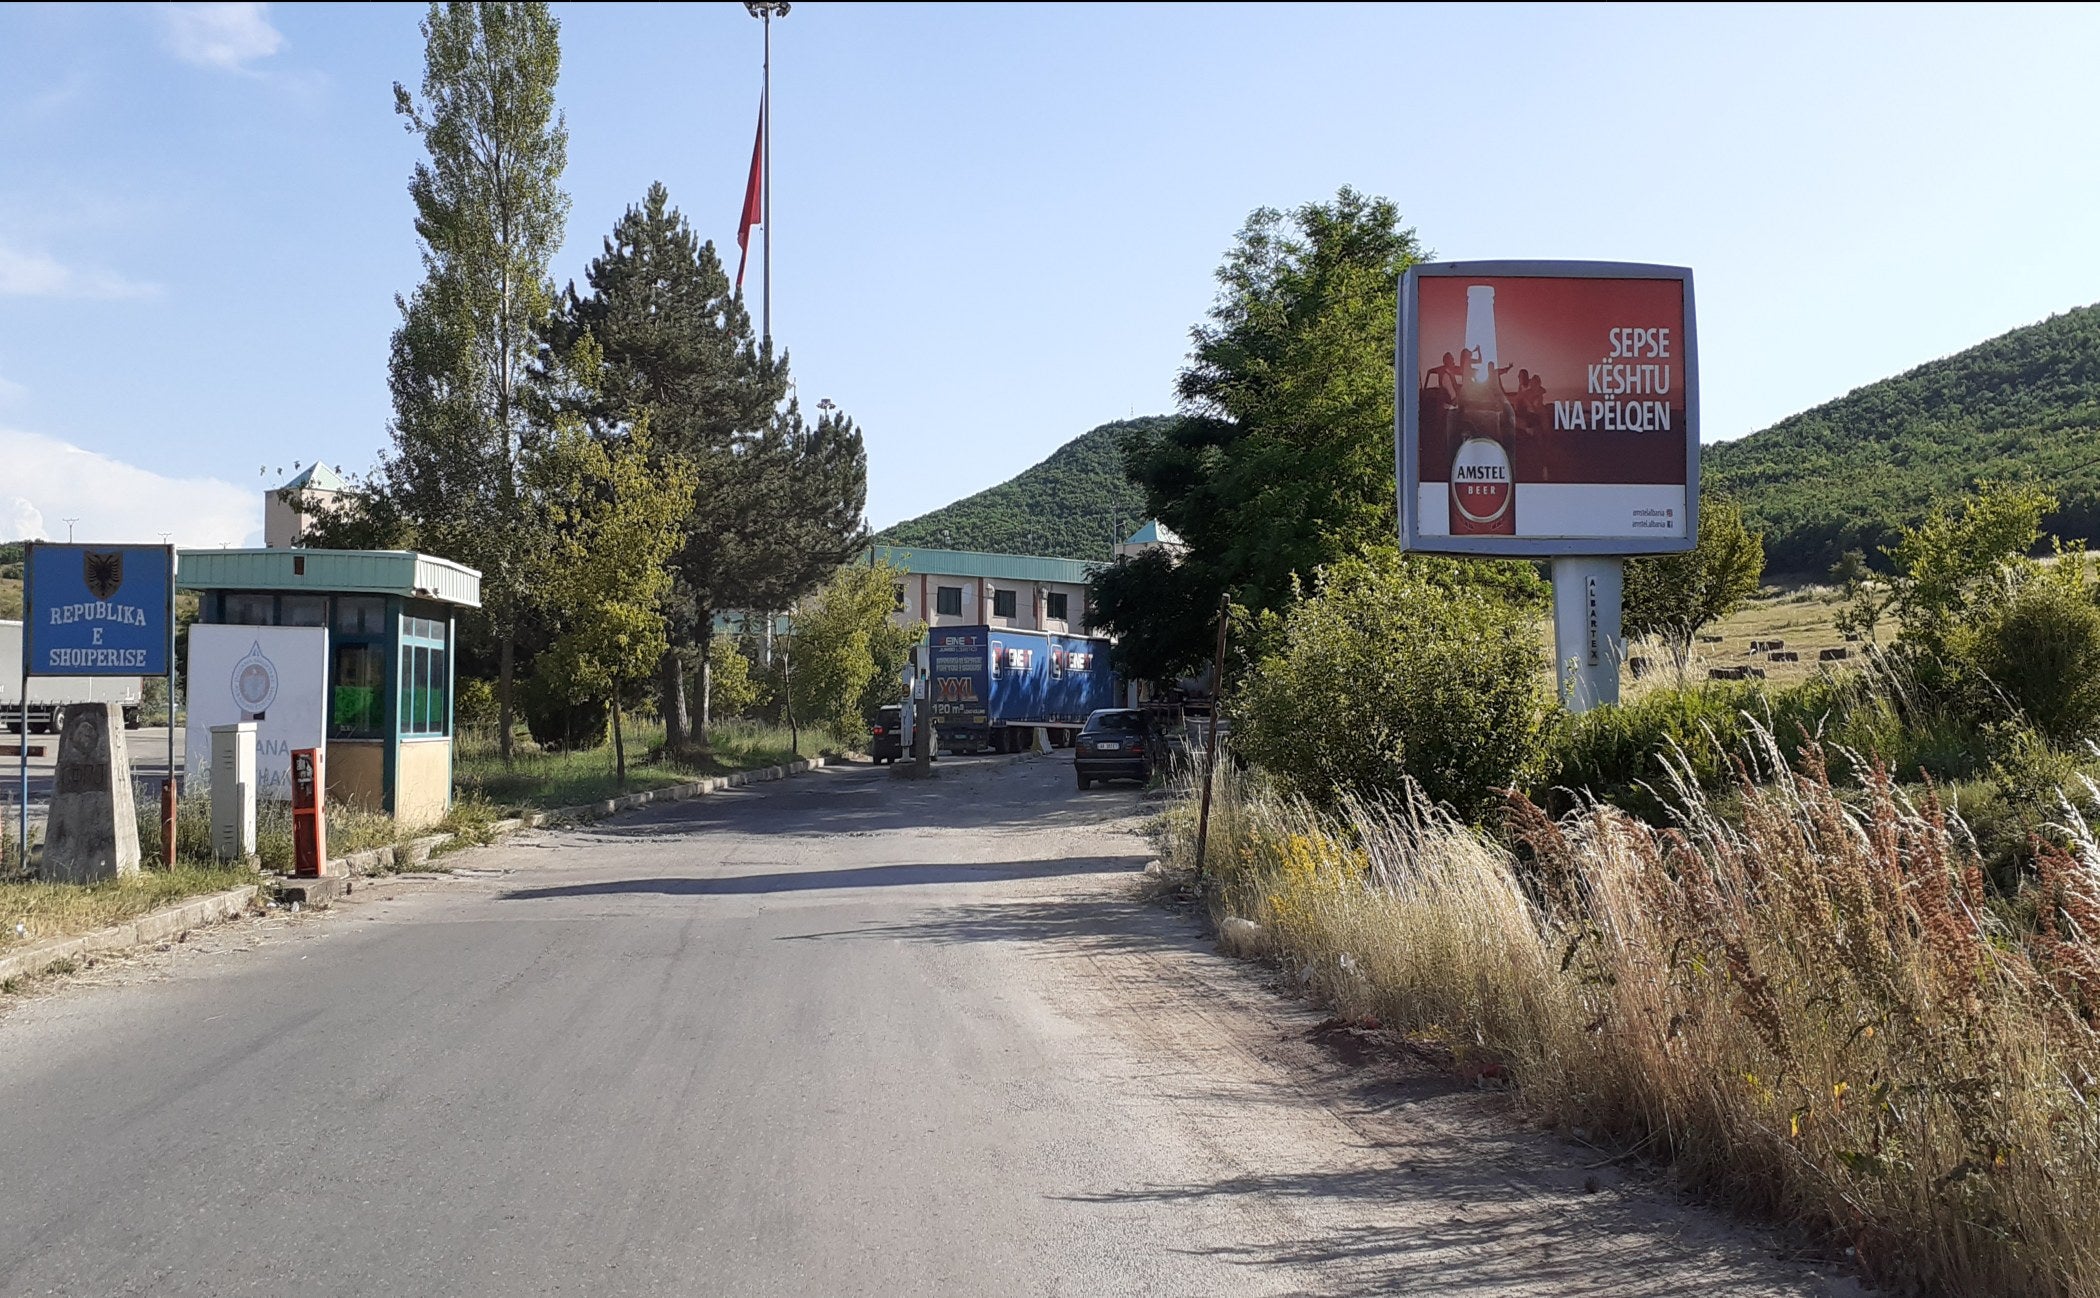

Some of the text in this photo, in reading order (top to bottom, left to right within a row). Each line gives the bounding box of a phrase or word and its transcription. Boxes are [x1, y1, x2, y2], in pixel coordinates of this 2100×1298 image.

[1609, 327, 1670, 358] SEPSE
[1588, 357, 1670, 394] KËSHTU
[1554, 394, 1671, 433] NA PËLQEN
[1457, 465, 1505, 480] AMSTEL
[1468, 485, 1496, 495] BEER
[49, 601, 147, 626] REPUBLIKA
[1589, 578, 1598, 659] ALBARTEX
[92, 627, 103, 645] E
[49, 648, 147, 667] SHQIPERISE
[937, 677, 979, 702] XXL
[932, 703, 951, 715] 120
[256, 739, 290, 756] ANA
